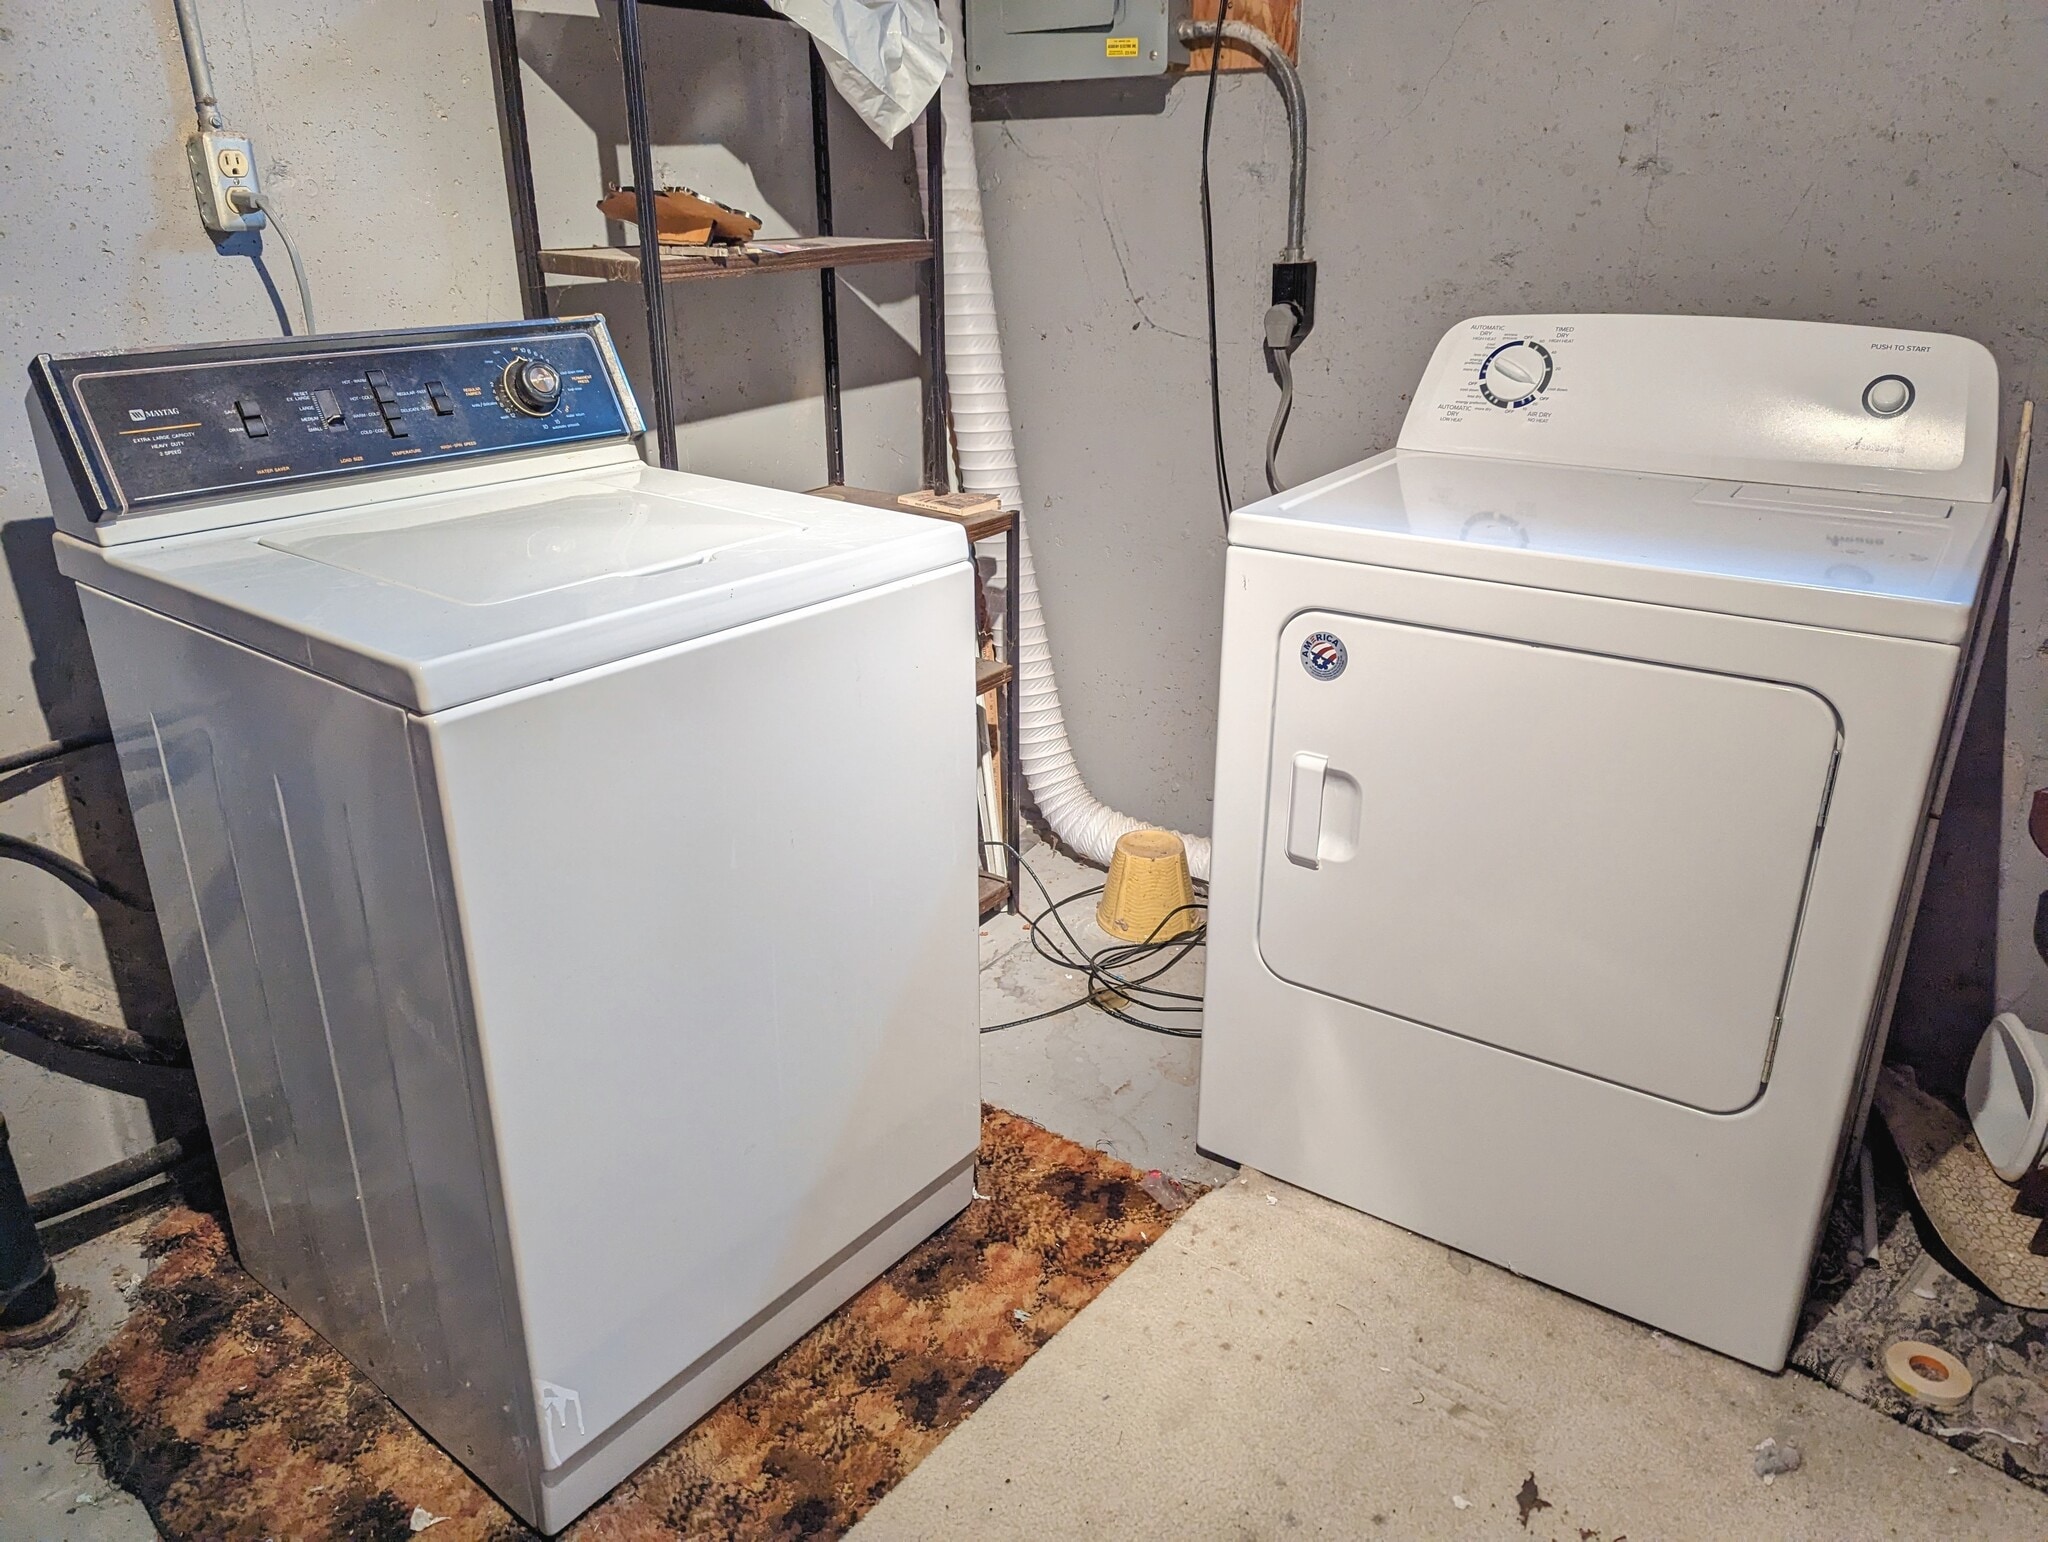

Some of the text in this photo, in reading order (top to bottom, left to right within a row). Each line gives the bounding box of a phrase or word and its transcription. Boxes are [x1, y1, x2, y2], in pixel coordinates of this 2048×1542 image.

[1906, 345, 1931, 353] START
[145, 408, 179, 418] MAYTAG
[391, 448, 422, 457] TEMPERATURE
[1302, 633, 1339, 658] AMERICA
